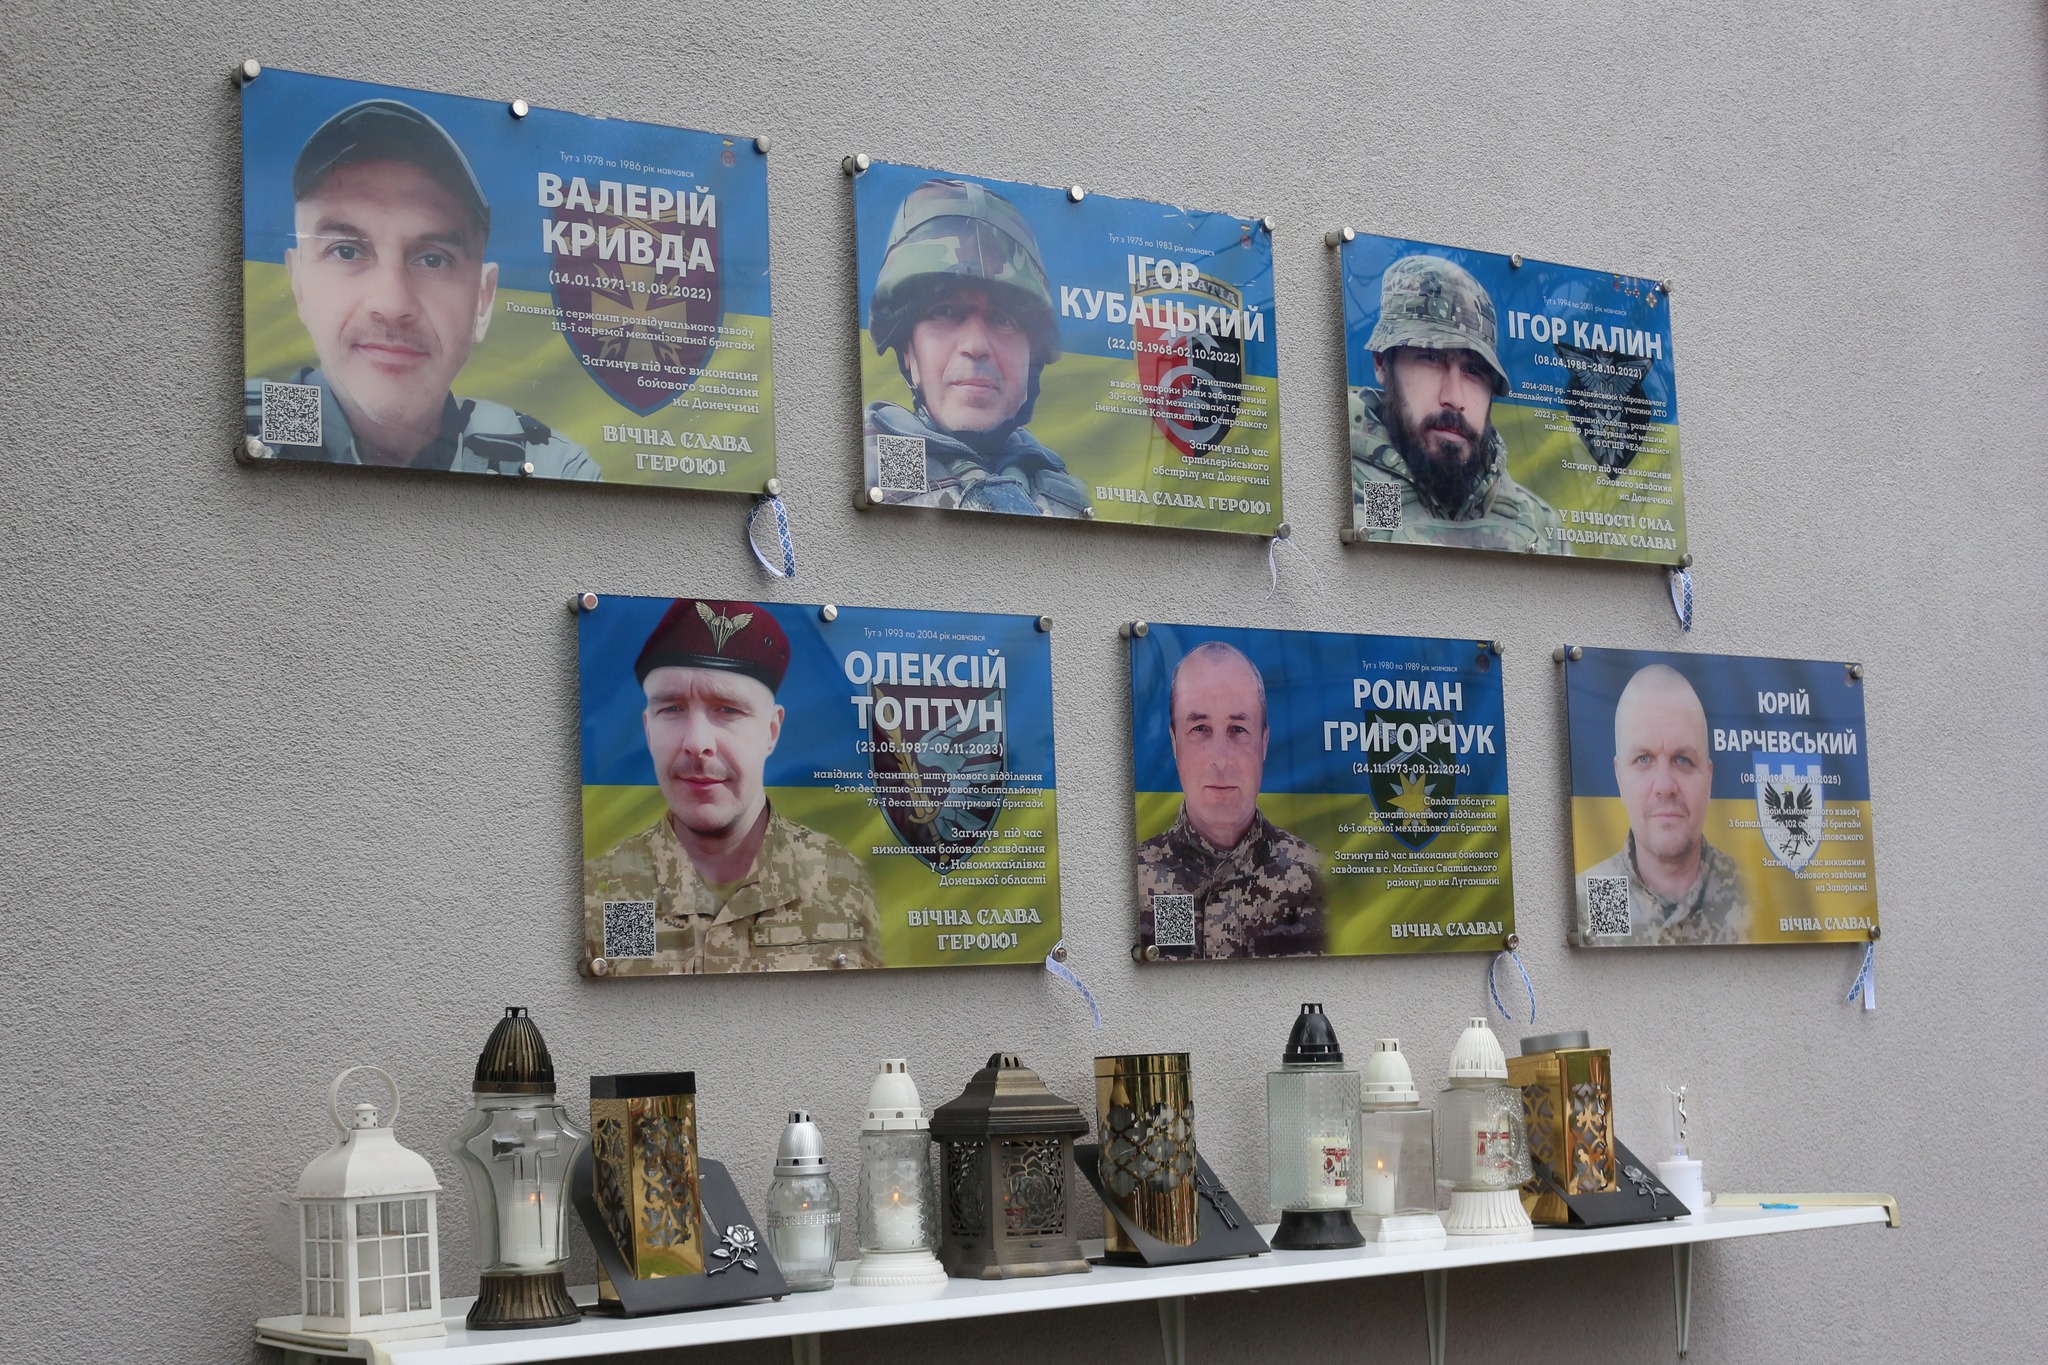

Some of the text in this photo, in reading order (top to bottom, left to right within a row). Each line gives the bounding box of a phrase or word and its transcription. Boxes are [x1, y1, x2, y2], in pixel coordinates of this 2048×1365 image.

[559, 151, 694, 179] Тут 1978 по 1986 рік навчався
[538, 172, 716, 228] ВАЛЕРІЙ
[542, 219, 715, 277] КРИВДА
[1108, 232, 1119, 243] Тут
[1126, 235, 1143, 245] 1975
[1155, 239, 1172, 250] 1983
[1127, 254, 1200, 292] ІГОР
[548, 269, 712, 302] (14.01.1971-18.08.2022)
[506, 301, 754, 339] Головний сержант розвідувального взводу
[1060, 286, 1264, 342] КУБАЦЬКИЙ
[551, 320, 755, 351] 115-ї окремої механізованої бригади
[1507, 310, 1662, 359] ІГОР КАЛИН
[1107, 336, 1240, 366] (22.05.1968-02.10.2022)
[582, 354, 758, 381] Загинув під час виконання
[636, 375, 759, 397] бойового завдання
[1109, 380, 1267, 404] взводу охорони роти забезпечення
[1190, 375, 1266, 392] Гранатометник
[1521, 381, 1553, 392] 2014-2018
[672, 396, 759, 413] на Донеччині
[1108, 391, 1267, 416] 30-ї окремої механізованої бригади
[1652, 408, 1667, 417] АТО
[1094, 402, 1268, 429] імені князя Костянтина Острозького
[1533, 409, 1551, 419] 2022
[602, 421, 752, 454] ВІЧНА СЛАВА
[1189, 439, 1269, 456] Загинув під час
[635, 451, 727, 477] ГЕРОЮ!
[1181, 455, 1269, 471] артилерійського
[1561, 459, 1671, 480] Загинув час виконання
[1152, 466, 1269, 485] обстрілу на Донеччині
[1596, 476, 1672, 492] бойового завдання
[1095, 483, 1271, 516] ВІЧНА СЛАВА ГЕРОЮ!
[1630, 493, 1673, 505] Донеччині
[1556, 526, 1677, 551] ПОДВИГАХ СЛАВА!
[863, 627, 875, 638] Тут
[884, 628, 903, 637] 1993
[916, 630, 937, 639] 2004
[939, 631, 950, 642] рік
[951, 633, 985, 642] навчався
[844, 649, 1006, 688] ОЛЕКСІЙ
[1361, 660, 1420, 670] Тут 1980 1989
[1352, 677, 1463, 712] РОМАН
[1757, 689, 1810, 715] ЮРІЙ
[850, 693, 1002, 734] ТОПТУН
[1323, 720, 1495, 754] ГРИГОРЧУК
[1714, 729, 1857, 755] ВАРЧЕВСЬКИЙ
[855, 739, 1003, 757] (23.05.1987-09.11.2023)
[813, 768, 1042, 782] навідник десантно-штурмового відділення
[1352, 761, 1470, 776] (24.11.1973-08.12.2024)
[833, 782, 1043, 797] 2-го десантно-штурмового батальйону
[866, 796, 1043, 810] 79-ї десантно-штурмової бригади
[1423, 796, 1496, 808] Солдат обслуги
[1368, 810, 1496, 821] гранатометного відділення
[1784, 819, 1861, 829] 102 бригади
[950, 827, 1042, 840] Загинув під час
[1338, 823, 1497, 835] 66-ї окремої механізованої бригади
[871, 843, 1045, 853] виконання бойового завдання
[1334, 849, 1498, 863] Загинув під час виконання бойового
[950, 859, 1046, 869] Новомихайлівка
[1330, 863, 1497, 874] завдання Макіївка Сватівського
[1809, 858, 1822, 866] час
[938, 874, 1046, 887] Донецької області
[1386, 875, 1500, 890] району, що на Луганщині
[907, 905, 1041, 927] ВІЧНА СЛАВА
[1779, 915, 1822, 931] ВІЧНА
[1390, 919, 1503, 938] ВІЧНА СЛАВА!
[937, 931, 1018, 952] ГЕРОЮ!
